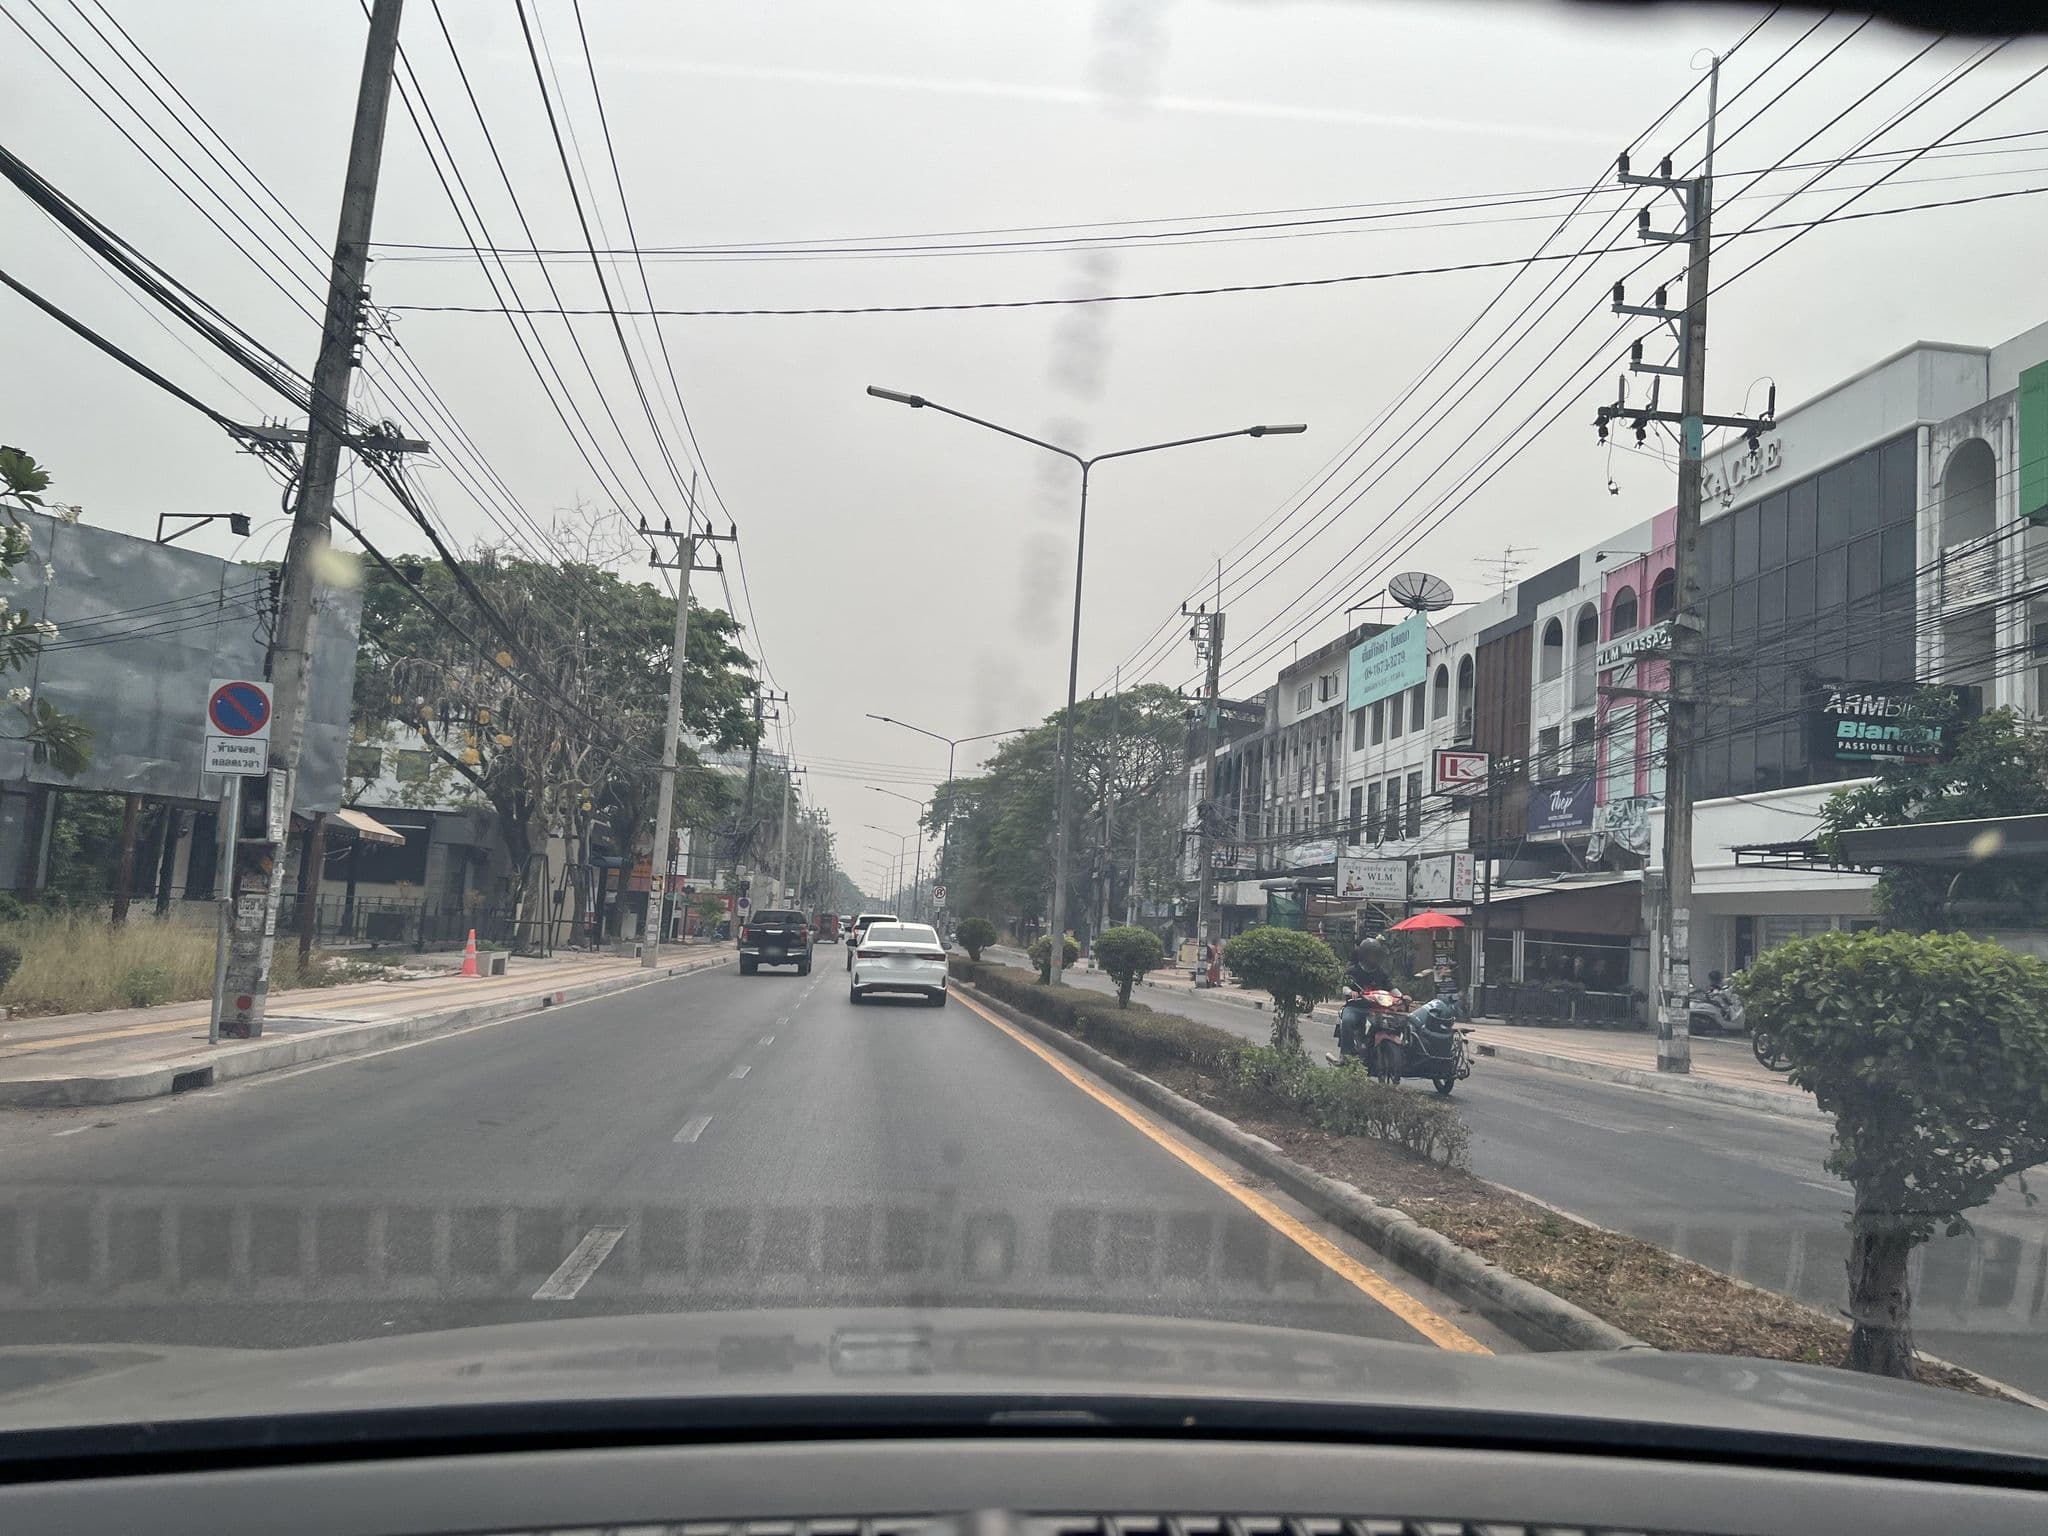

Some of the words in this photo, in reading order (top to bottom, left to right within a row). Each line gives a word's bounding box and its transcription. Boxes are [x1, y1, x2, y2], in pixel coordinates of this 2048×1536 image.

[1836, 720, 1943, 741] Bianhi
[217, 741, 256, 754] ห้ามจอด
[1838, 741, 1892, 752] PASSIONE
[212, 758, 260, 769] ตลอดเวลา
[1367, 873, 1393, 881] WLM
